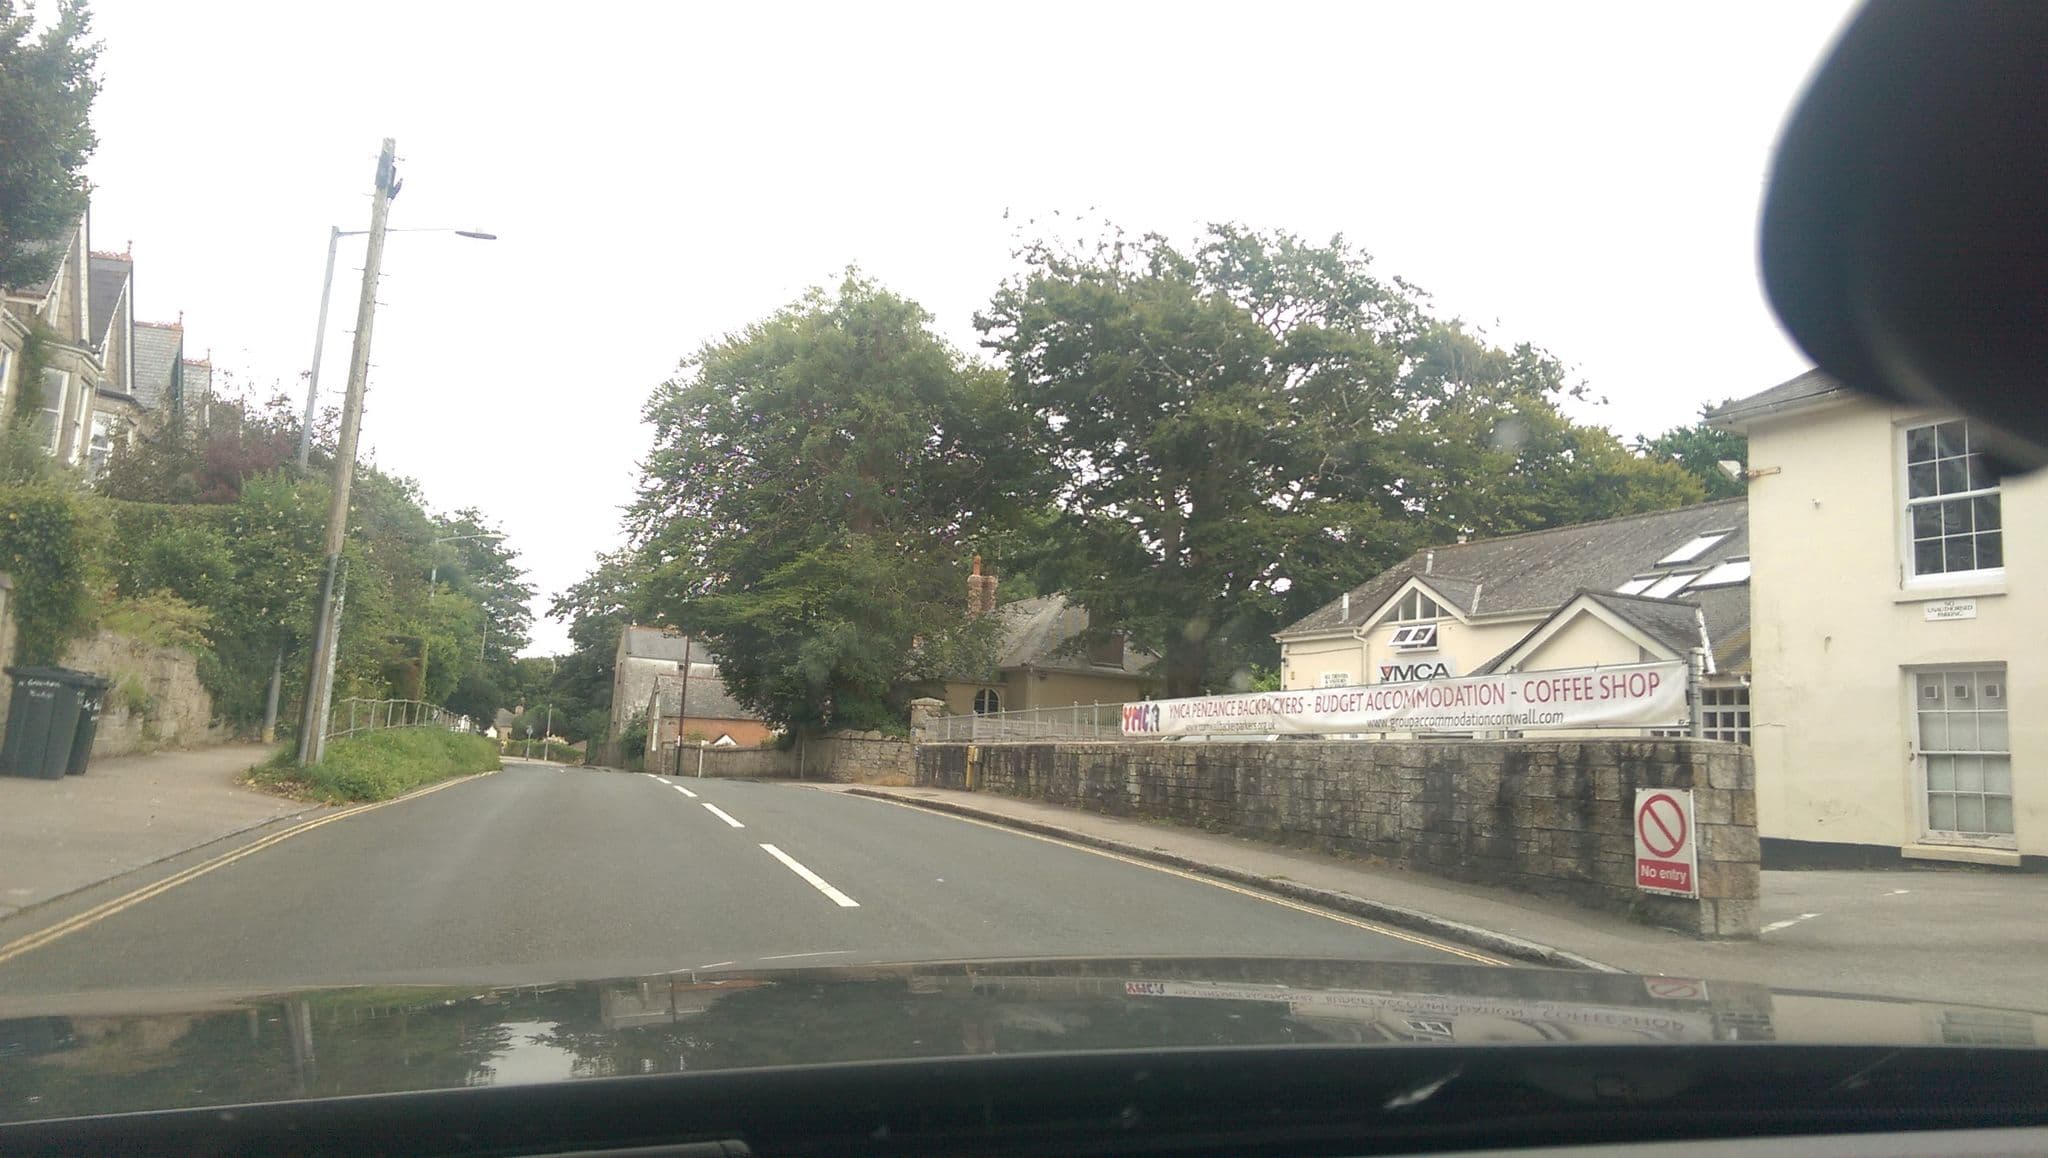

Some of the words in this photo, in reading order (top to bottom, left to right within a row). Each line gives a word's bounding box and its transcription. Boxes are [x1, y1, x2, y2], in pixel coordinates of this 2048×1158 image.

[1380, 663, 1451, 682] YMCA
[1168, 703, 1191, 719] YMCA
[1192, 700, 1236, 718] PENZANCE
[1237, 697, 1305, 716] BACKPACKERS
[1314, 693, 1364, 713] BUDGET
[1365, 683, 1505, 711] ACCOMMODATION
[1523, 677, 1594, 703] COFFEE
[1600, 672, 1660, 700] SHOP
[1122, 703, 1160, 733] YMCA
[1367, 708, 1564, 731] www.groupaccommodationcornwall.com
[1640, 864, 1657, 878] No
[1659, 868, 1687, 885] entry
